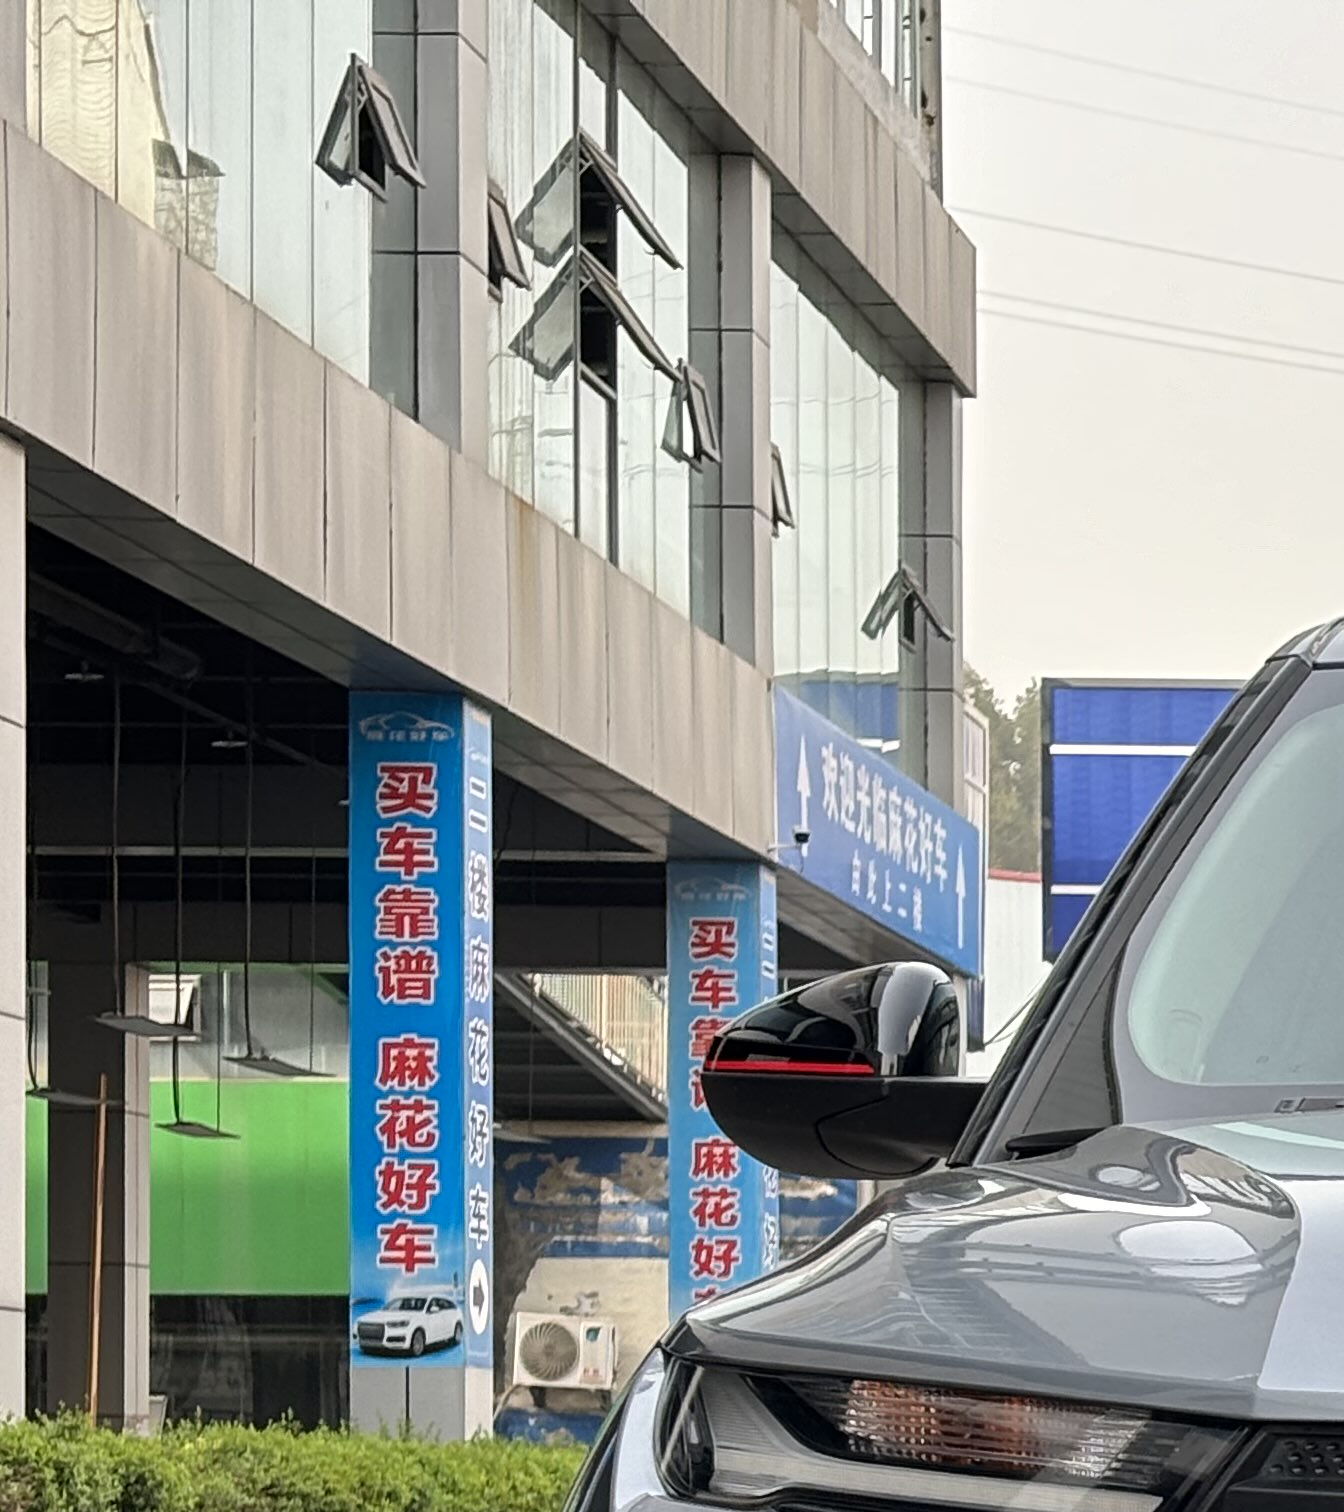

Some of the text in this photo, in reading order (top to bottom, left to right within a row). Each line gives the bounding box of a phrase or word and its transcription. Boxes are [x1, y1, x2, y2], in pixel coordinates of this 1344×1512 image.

[375, 762, 439, 1004] 买车靠谱
[821, 742, 947, 892] 欢迎光临麻花好车
[689, 917, 737, 1112] 买车靠
[375, 1034, 439, 1274] 麻花好车
[689, 1136, 741, 1300] 麻花好
